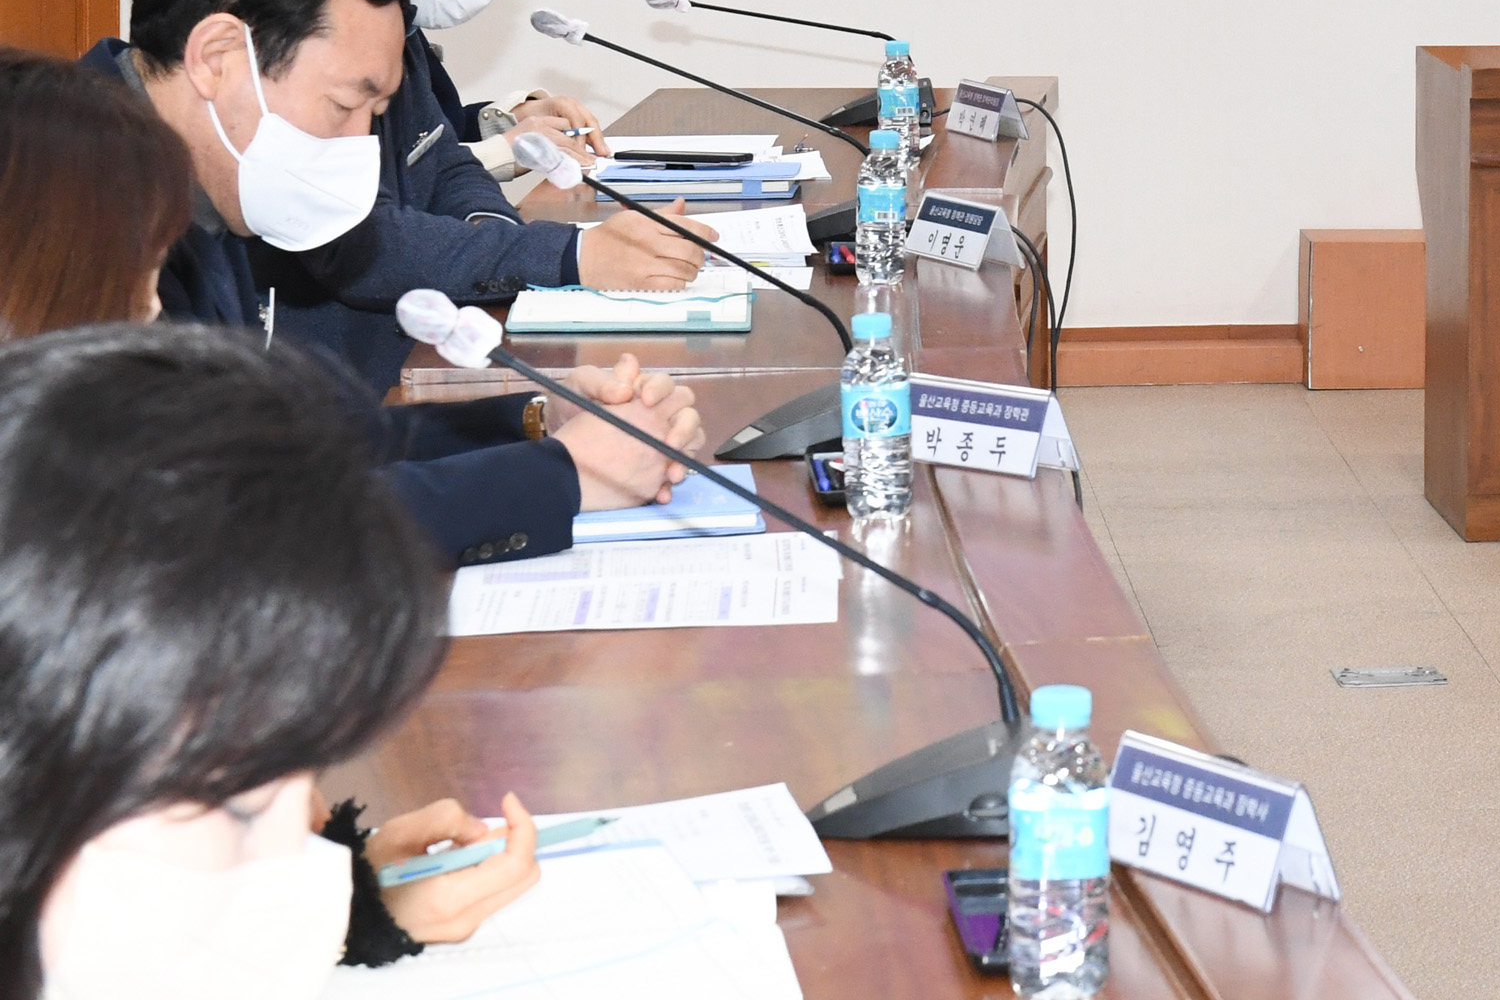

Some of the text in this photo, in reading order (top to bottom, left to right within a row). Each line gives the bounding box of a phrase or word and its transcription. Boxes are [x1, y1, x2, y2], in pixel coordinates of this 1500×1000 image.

[918, 393, 1030, 422] 울산교육청 중등교육과 장학관
